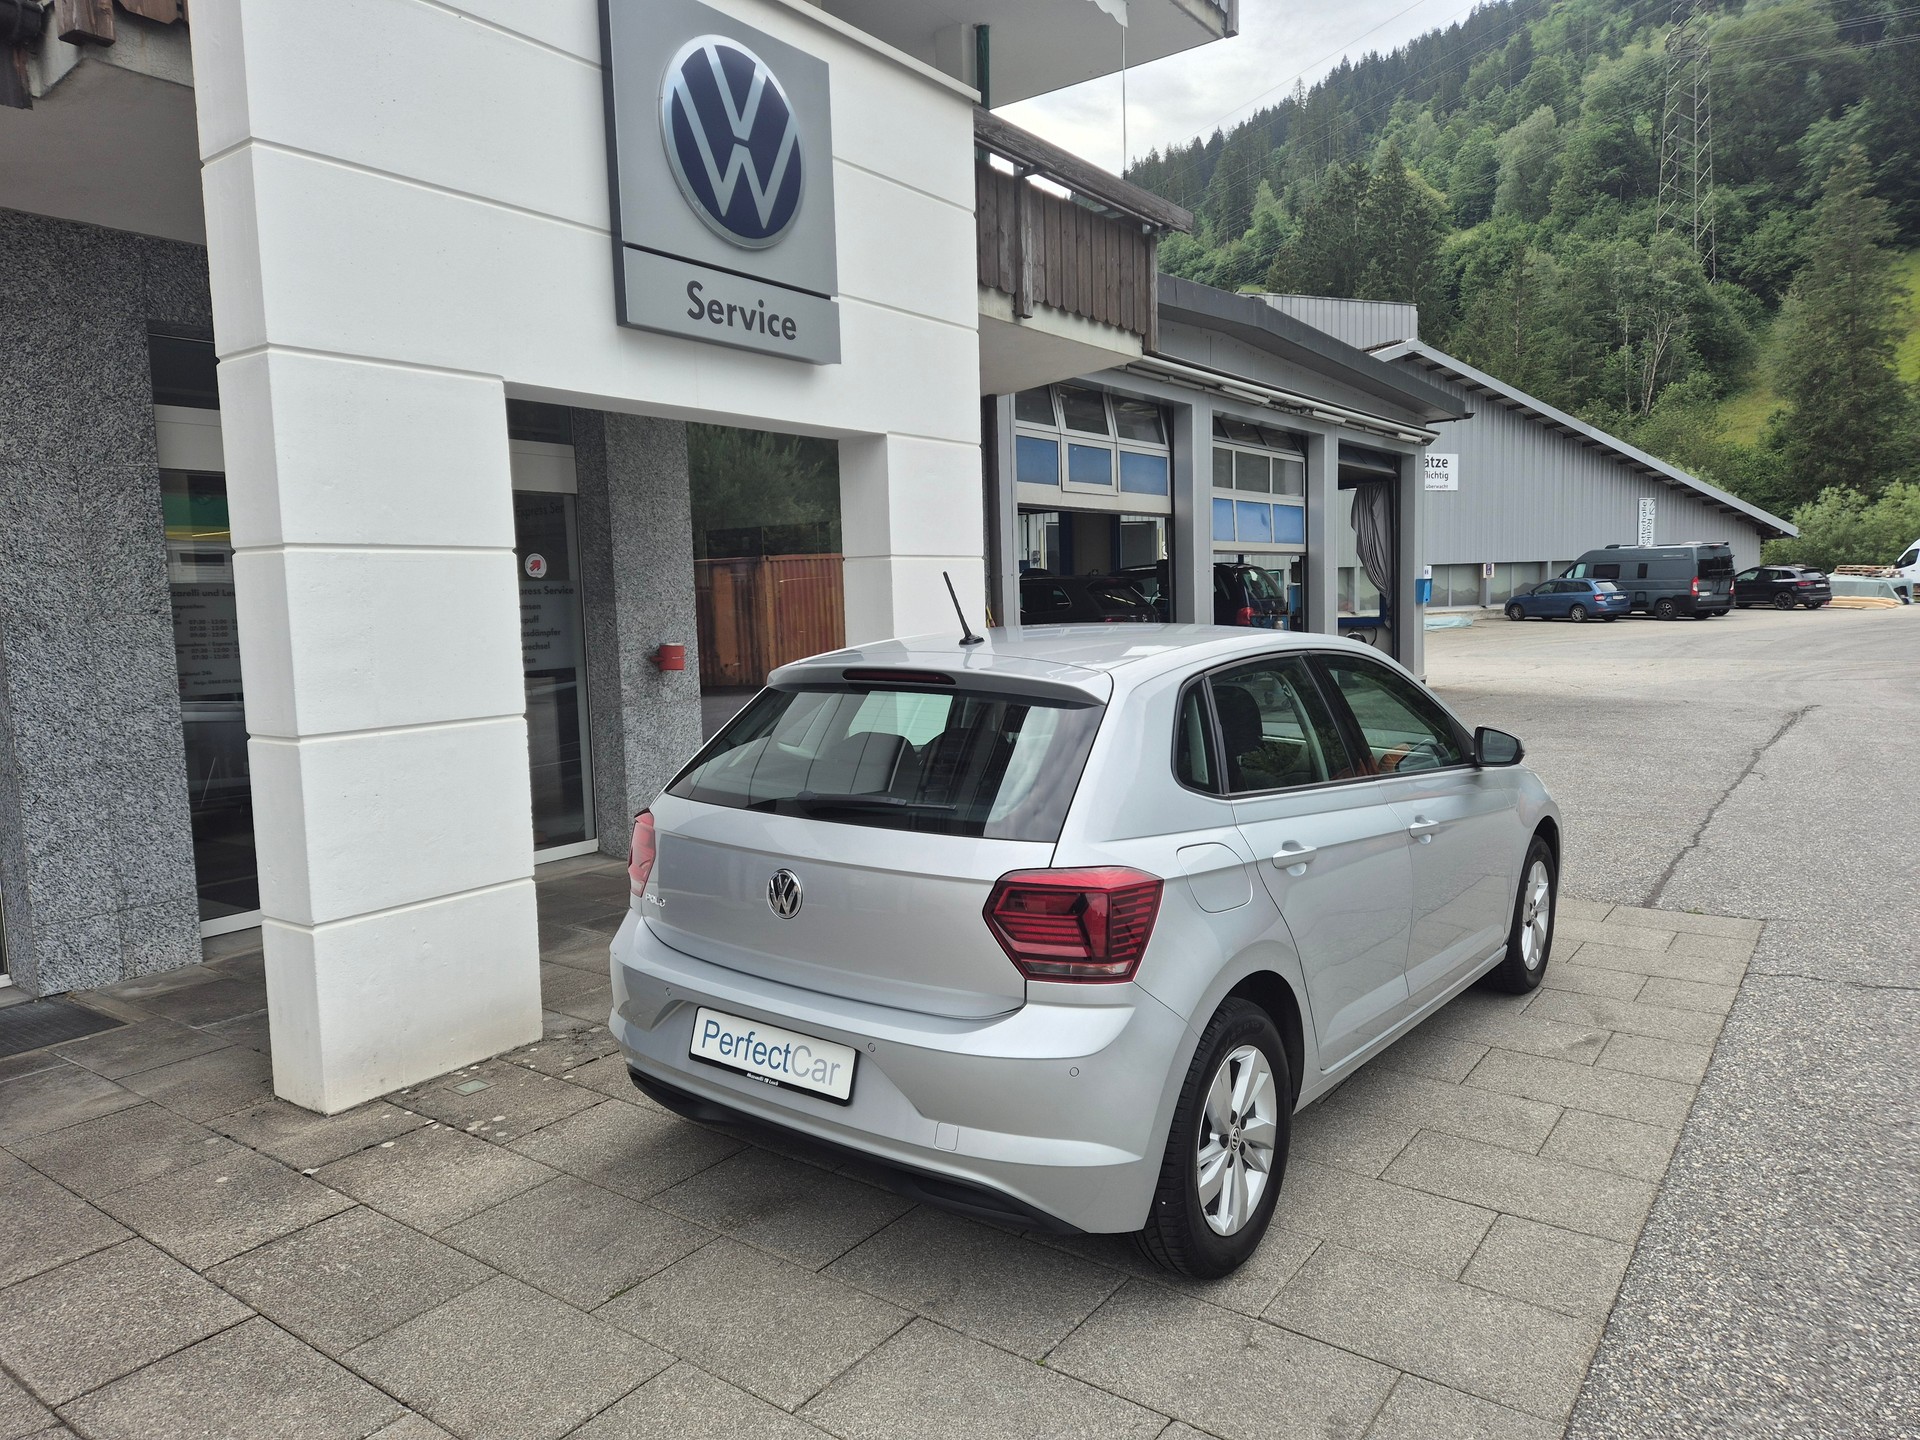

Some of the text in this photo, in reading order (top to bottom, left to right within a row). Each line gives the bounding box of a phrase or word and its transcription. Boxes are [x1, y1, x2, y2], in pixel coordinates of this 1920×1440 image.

[686, 279, 797, 340] Service
[202, 588, 219, 597] und
[544, 585, 574, 595] Service
[522, 627, 561, 638] ssdämpfer
[646, 892, 666, 908] POLO
[702, 1019, 841, 1086] PerfectCar
